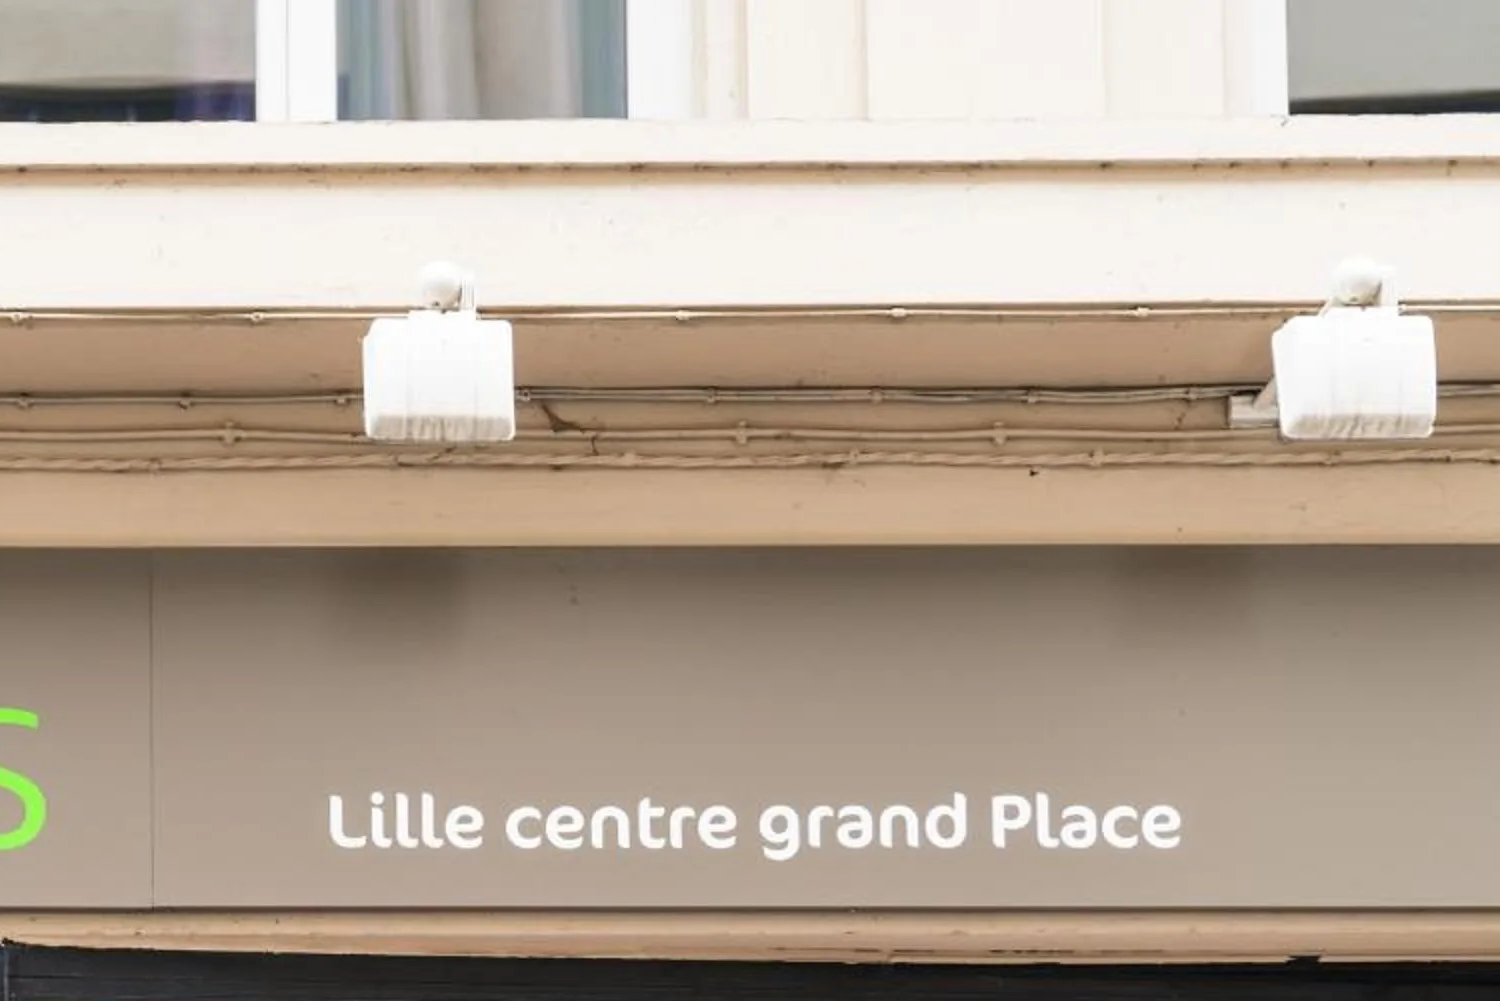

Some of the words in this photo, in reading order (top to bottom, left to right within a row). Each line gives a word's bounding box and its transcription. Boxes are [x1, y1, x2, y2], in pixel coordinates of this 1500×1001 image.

[328, 791, 484, 850] Lille
[505, 797, 738, 850] centre
[759, 791, 967, 862] grand
[990, 791, 1183, 850] Place
